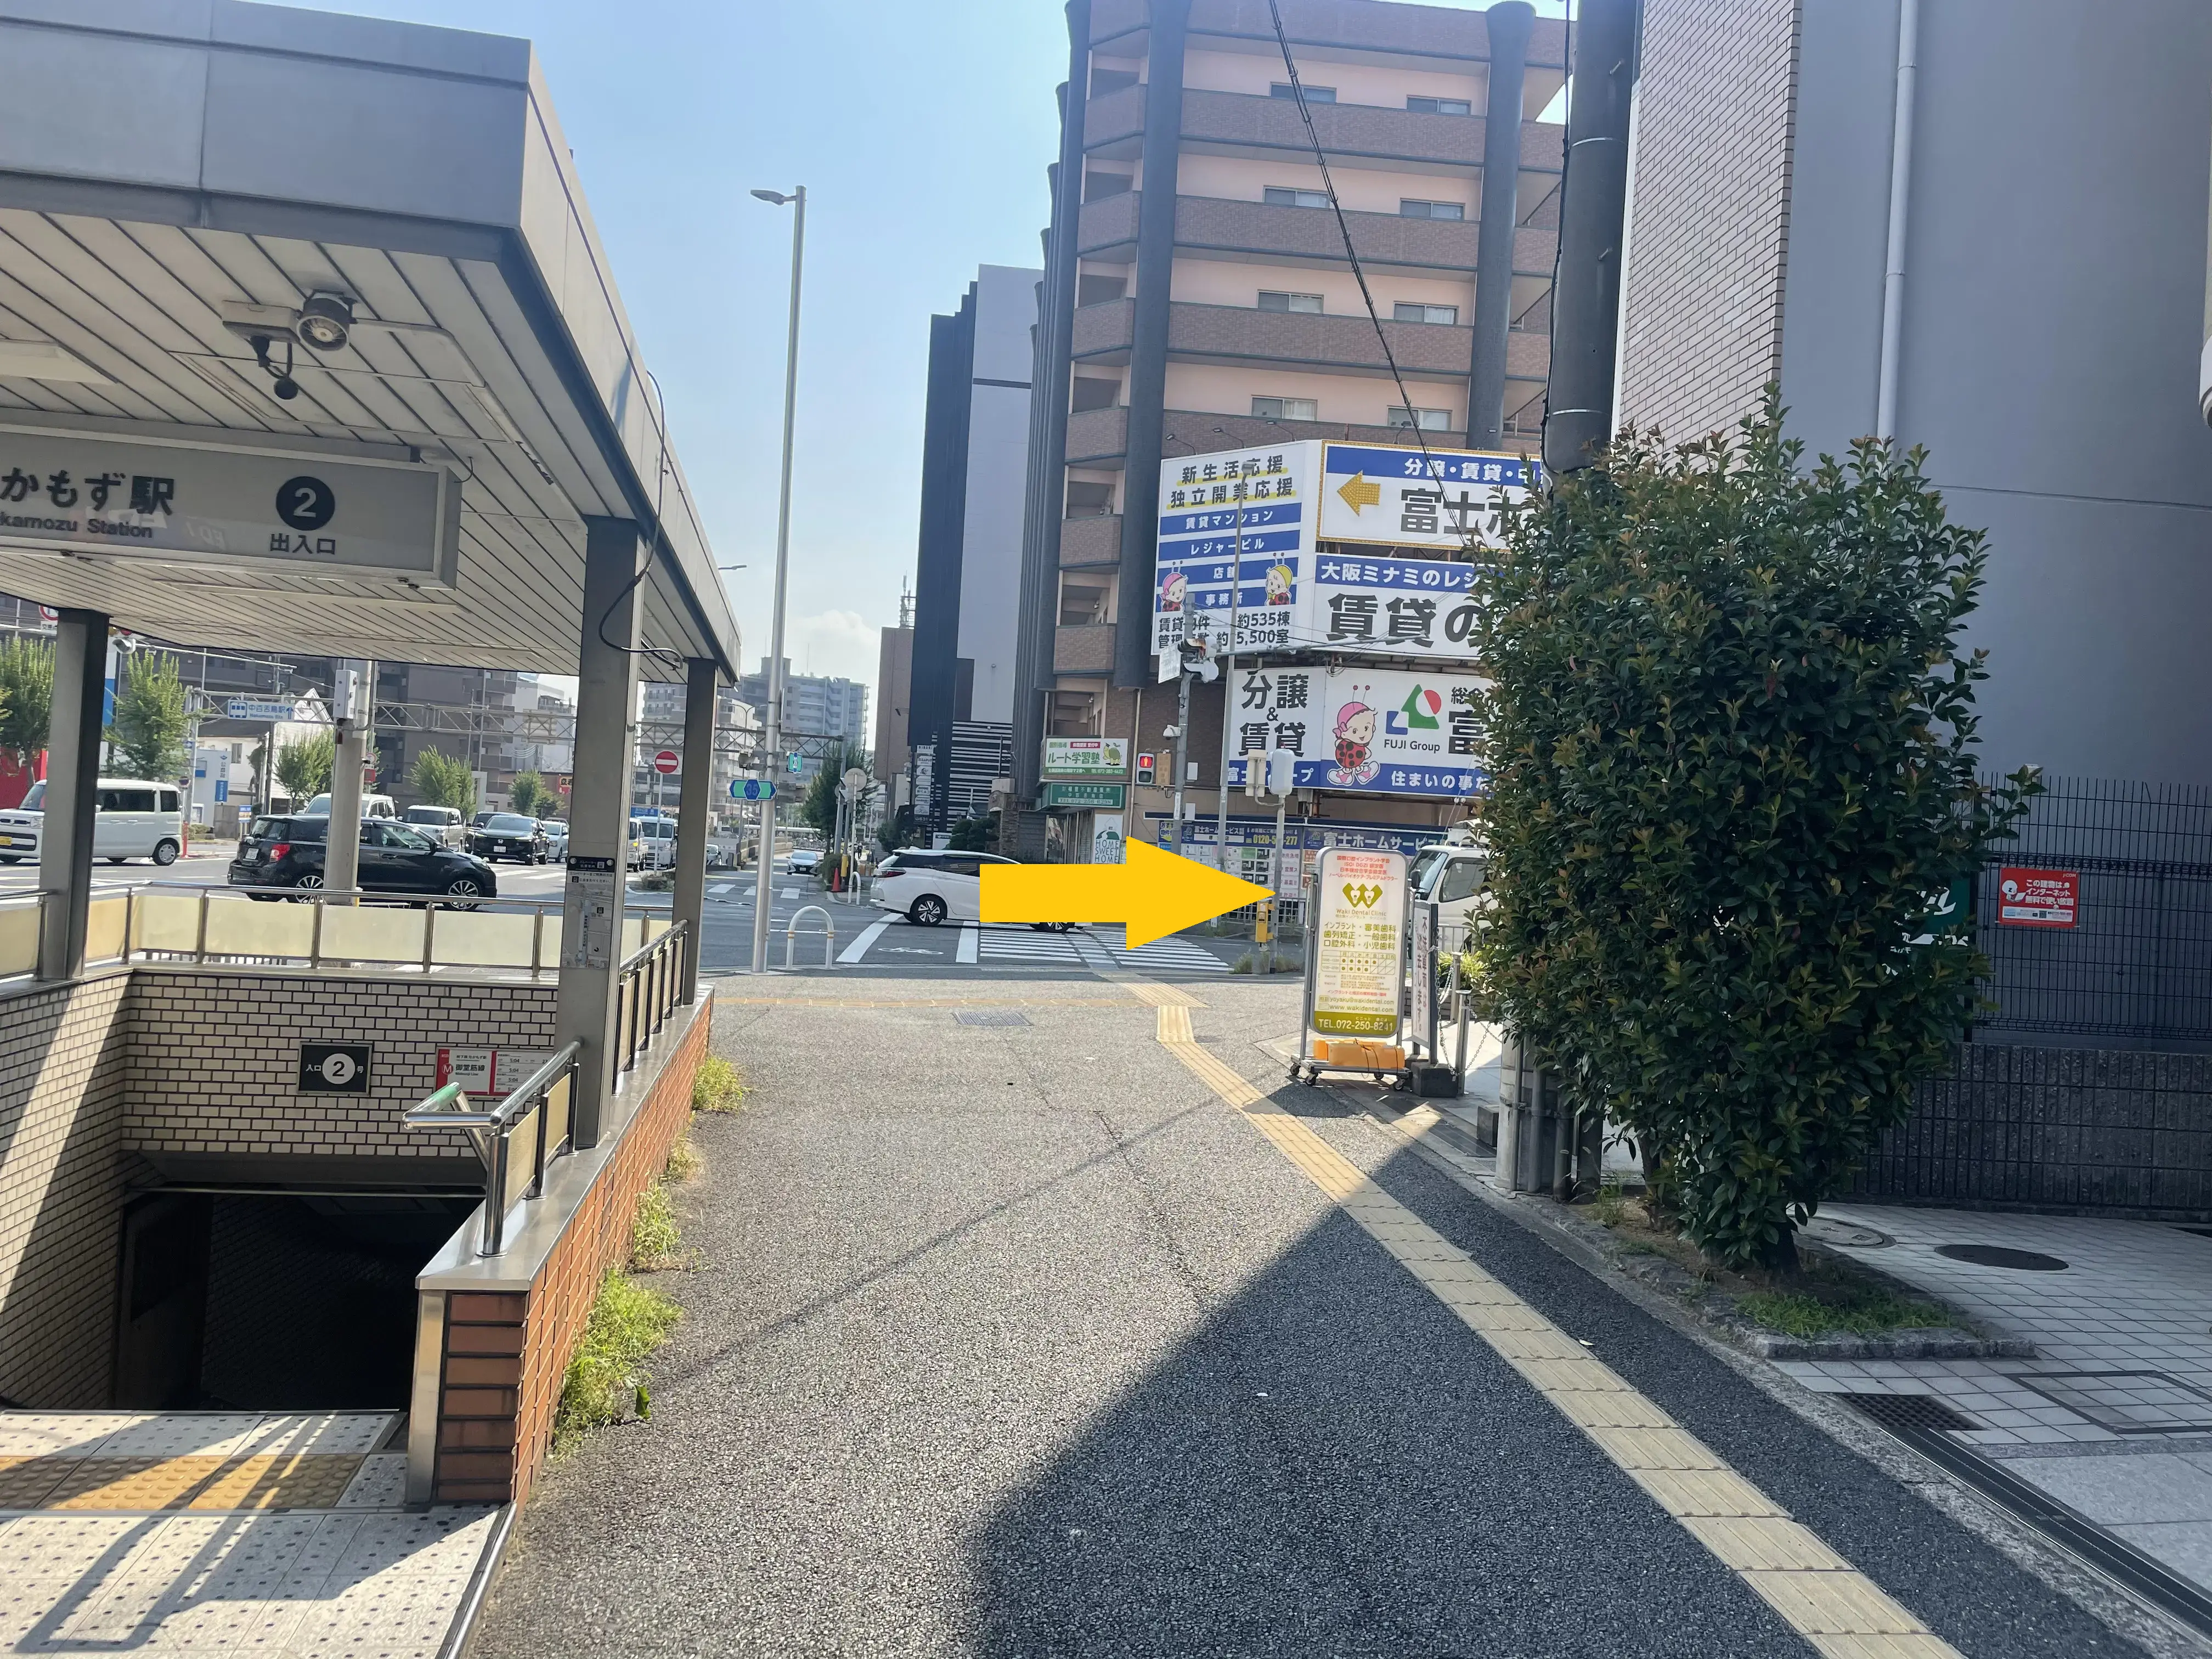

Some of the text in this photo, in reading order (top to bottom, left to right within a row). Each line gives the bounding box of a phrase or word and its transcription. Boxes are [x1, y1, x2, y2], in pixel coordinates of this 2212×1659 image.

[1170, 477, 1293, 509] 独立開業応援
[292, 487, 317, 518] 2
[87, 518, 153, 538] Station
[269, 533, 336, 555] 出入口
[1190, 538, 1265, 555] レジャービル
[1327, 592, 1483, 648] 賃貸の
[1241, 670, 1309, 710] 分譲
[1266, 706, 1279, 721] &
[1238, 721, 1307, 758] 賃貸
[1384, 738, 1441, 754] FUJI Group
[1048, 752, 1100, 764] ルート学習塾
[1096, 839, 1119, 848] HOME
[1094, 855, 1120, 864] HOME
[2026, 888, 2070, 897] インターネット
[1329, 1004, 1394, 1013] www.wakidental.com
[1330, 996, 1395, 1005] yoyaku@wakidental.com
[1318, 1018, 1393, 1032] TEL.072-250-8241
[306, 1064, 321, 1072] 入口
[332, 1060, 345, 1077] 2
